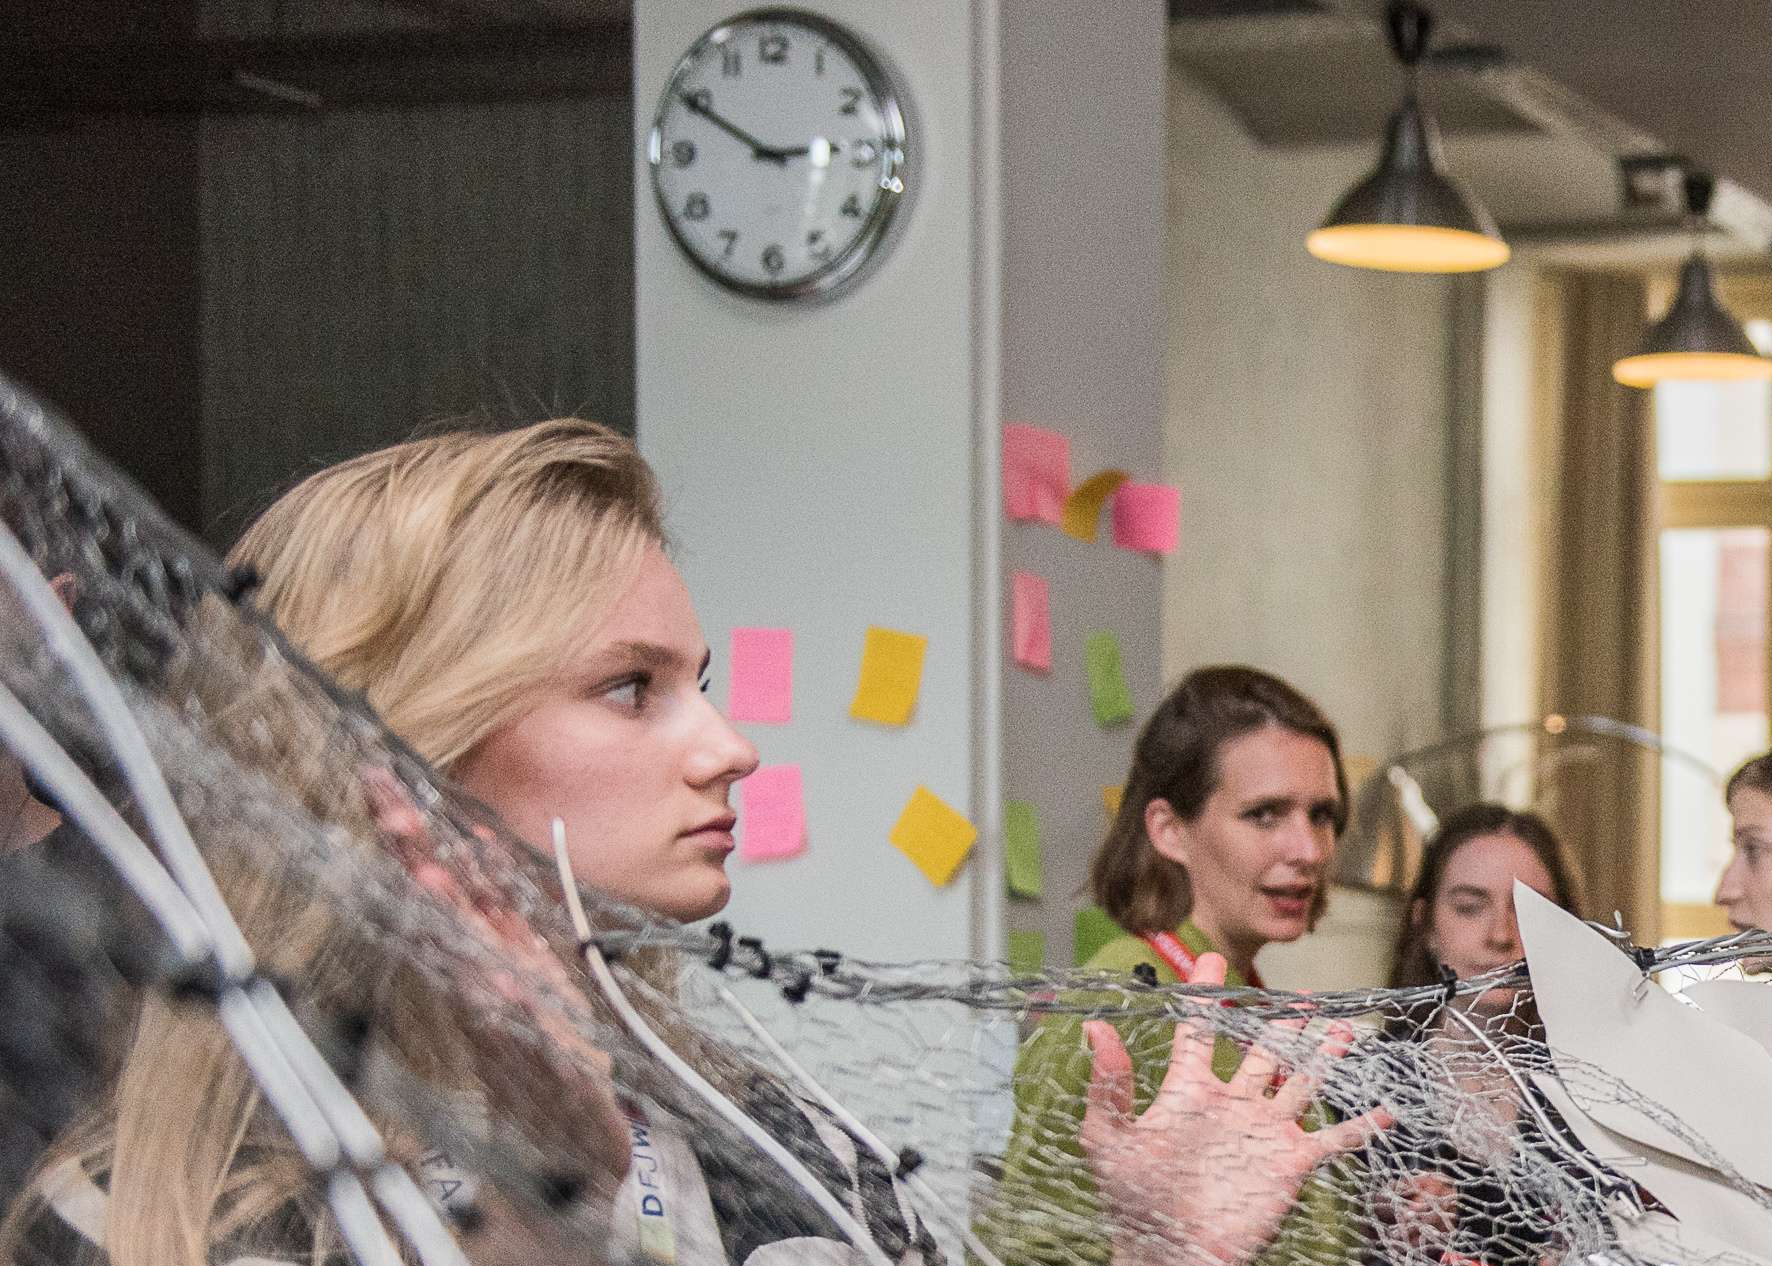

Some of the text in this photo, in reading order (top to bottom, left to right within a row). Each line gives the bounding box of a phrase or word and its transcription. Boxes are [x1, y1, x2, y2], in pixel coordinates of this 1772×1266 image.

[815, 49, 824, 76] 1
[839, 86, 862, 116] 2
[717, 229, 739, 257] 7
[631, 1120, 664, 1217] DFJW
